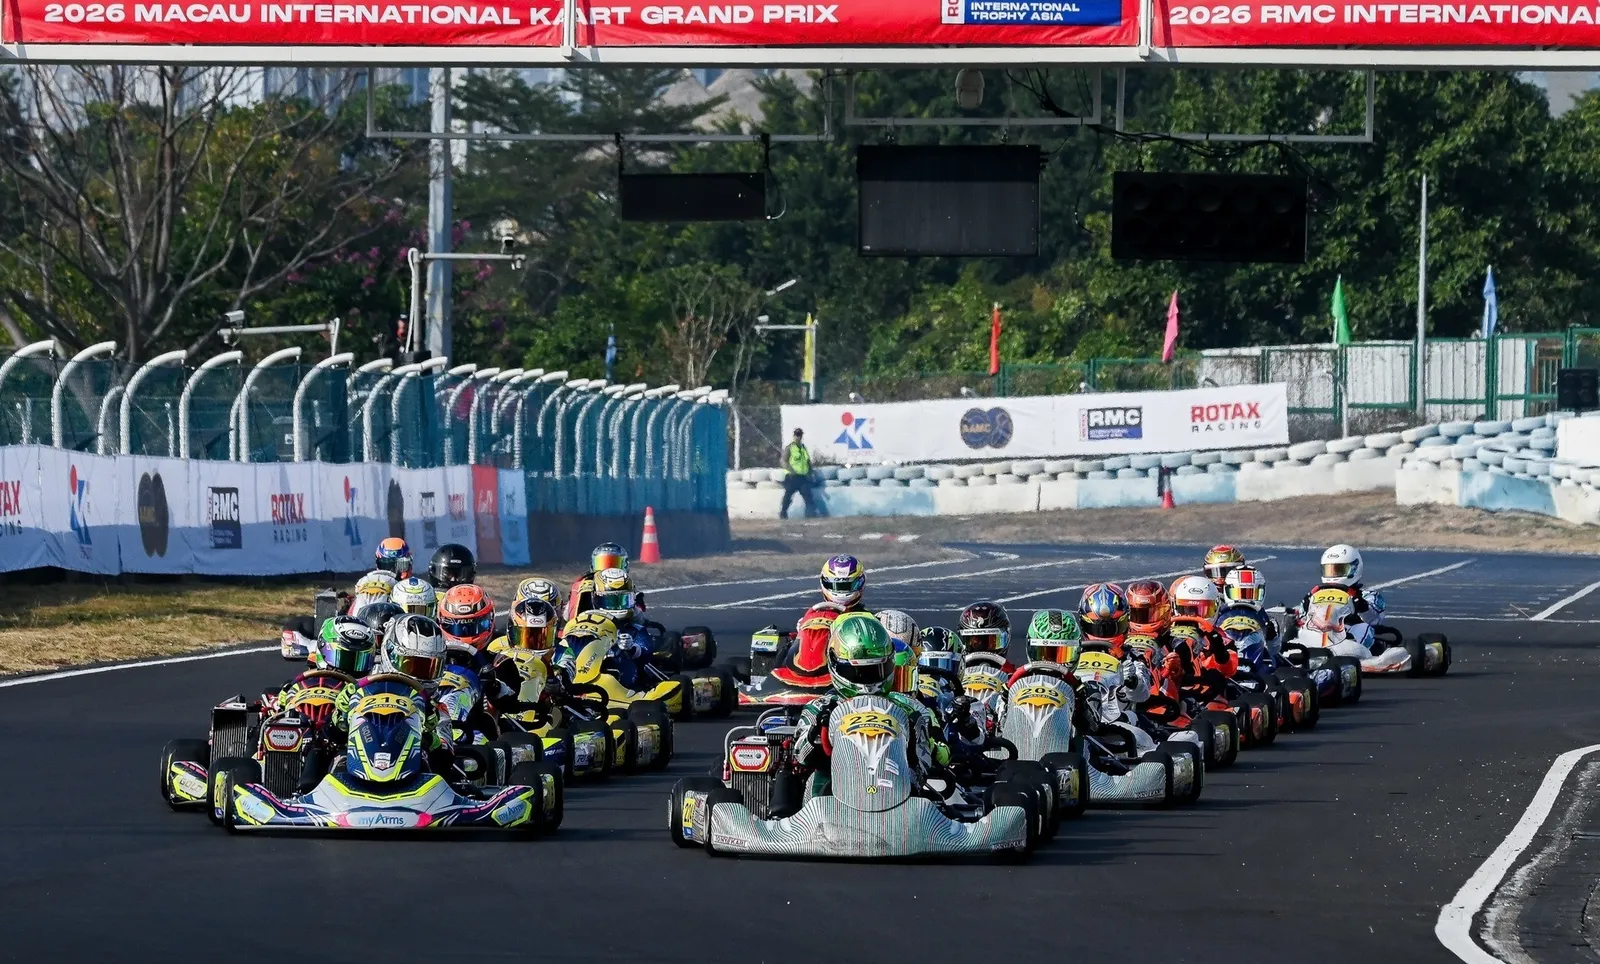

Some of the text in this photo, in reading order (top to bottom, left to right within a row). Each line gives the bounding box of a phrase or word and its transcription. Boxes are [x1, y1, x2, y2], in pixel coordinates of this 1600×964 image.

[970, 2, 1080, 12] INTERNATIONAL
[44, 3, 839, 25] 2026 MACAU INTERNATIONAL KART GRAND PRIX
[971, 11, 1064, 21] TROPHY ASIA
[1169, 5, 1600, 25] 2026 RMC INTERNATIONA
[1088, 408, 1141, 427] RMC
[1190, 402, 1262, 423] ROTAX
[1191, 421, 1262, 433] RACING
[212, 492, 239, 522] RMC
[271, 493, 307, 526] ROTAX
[1079, 660, 1114, 669] 207
[1021, 687, 1060, 697] 209
[364, 696, 408, 707] 216
[849, 715, 894, 727] 224
[358, 812, 405, 827] myArms
